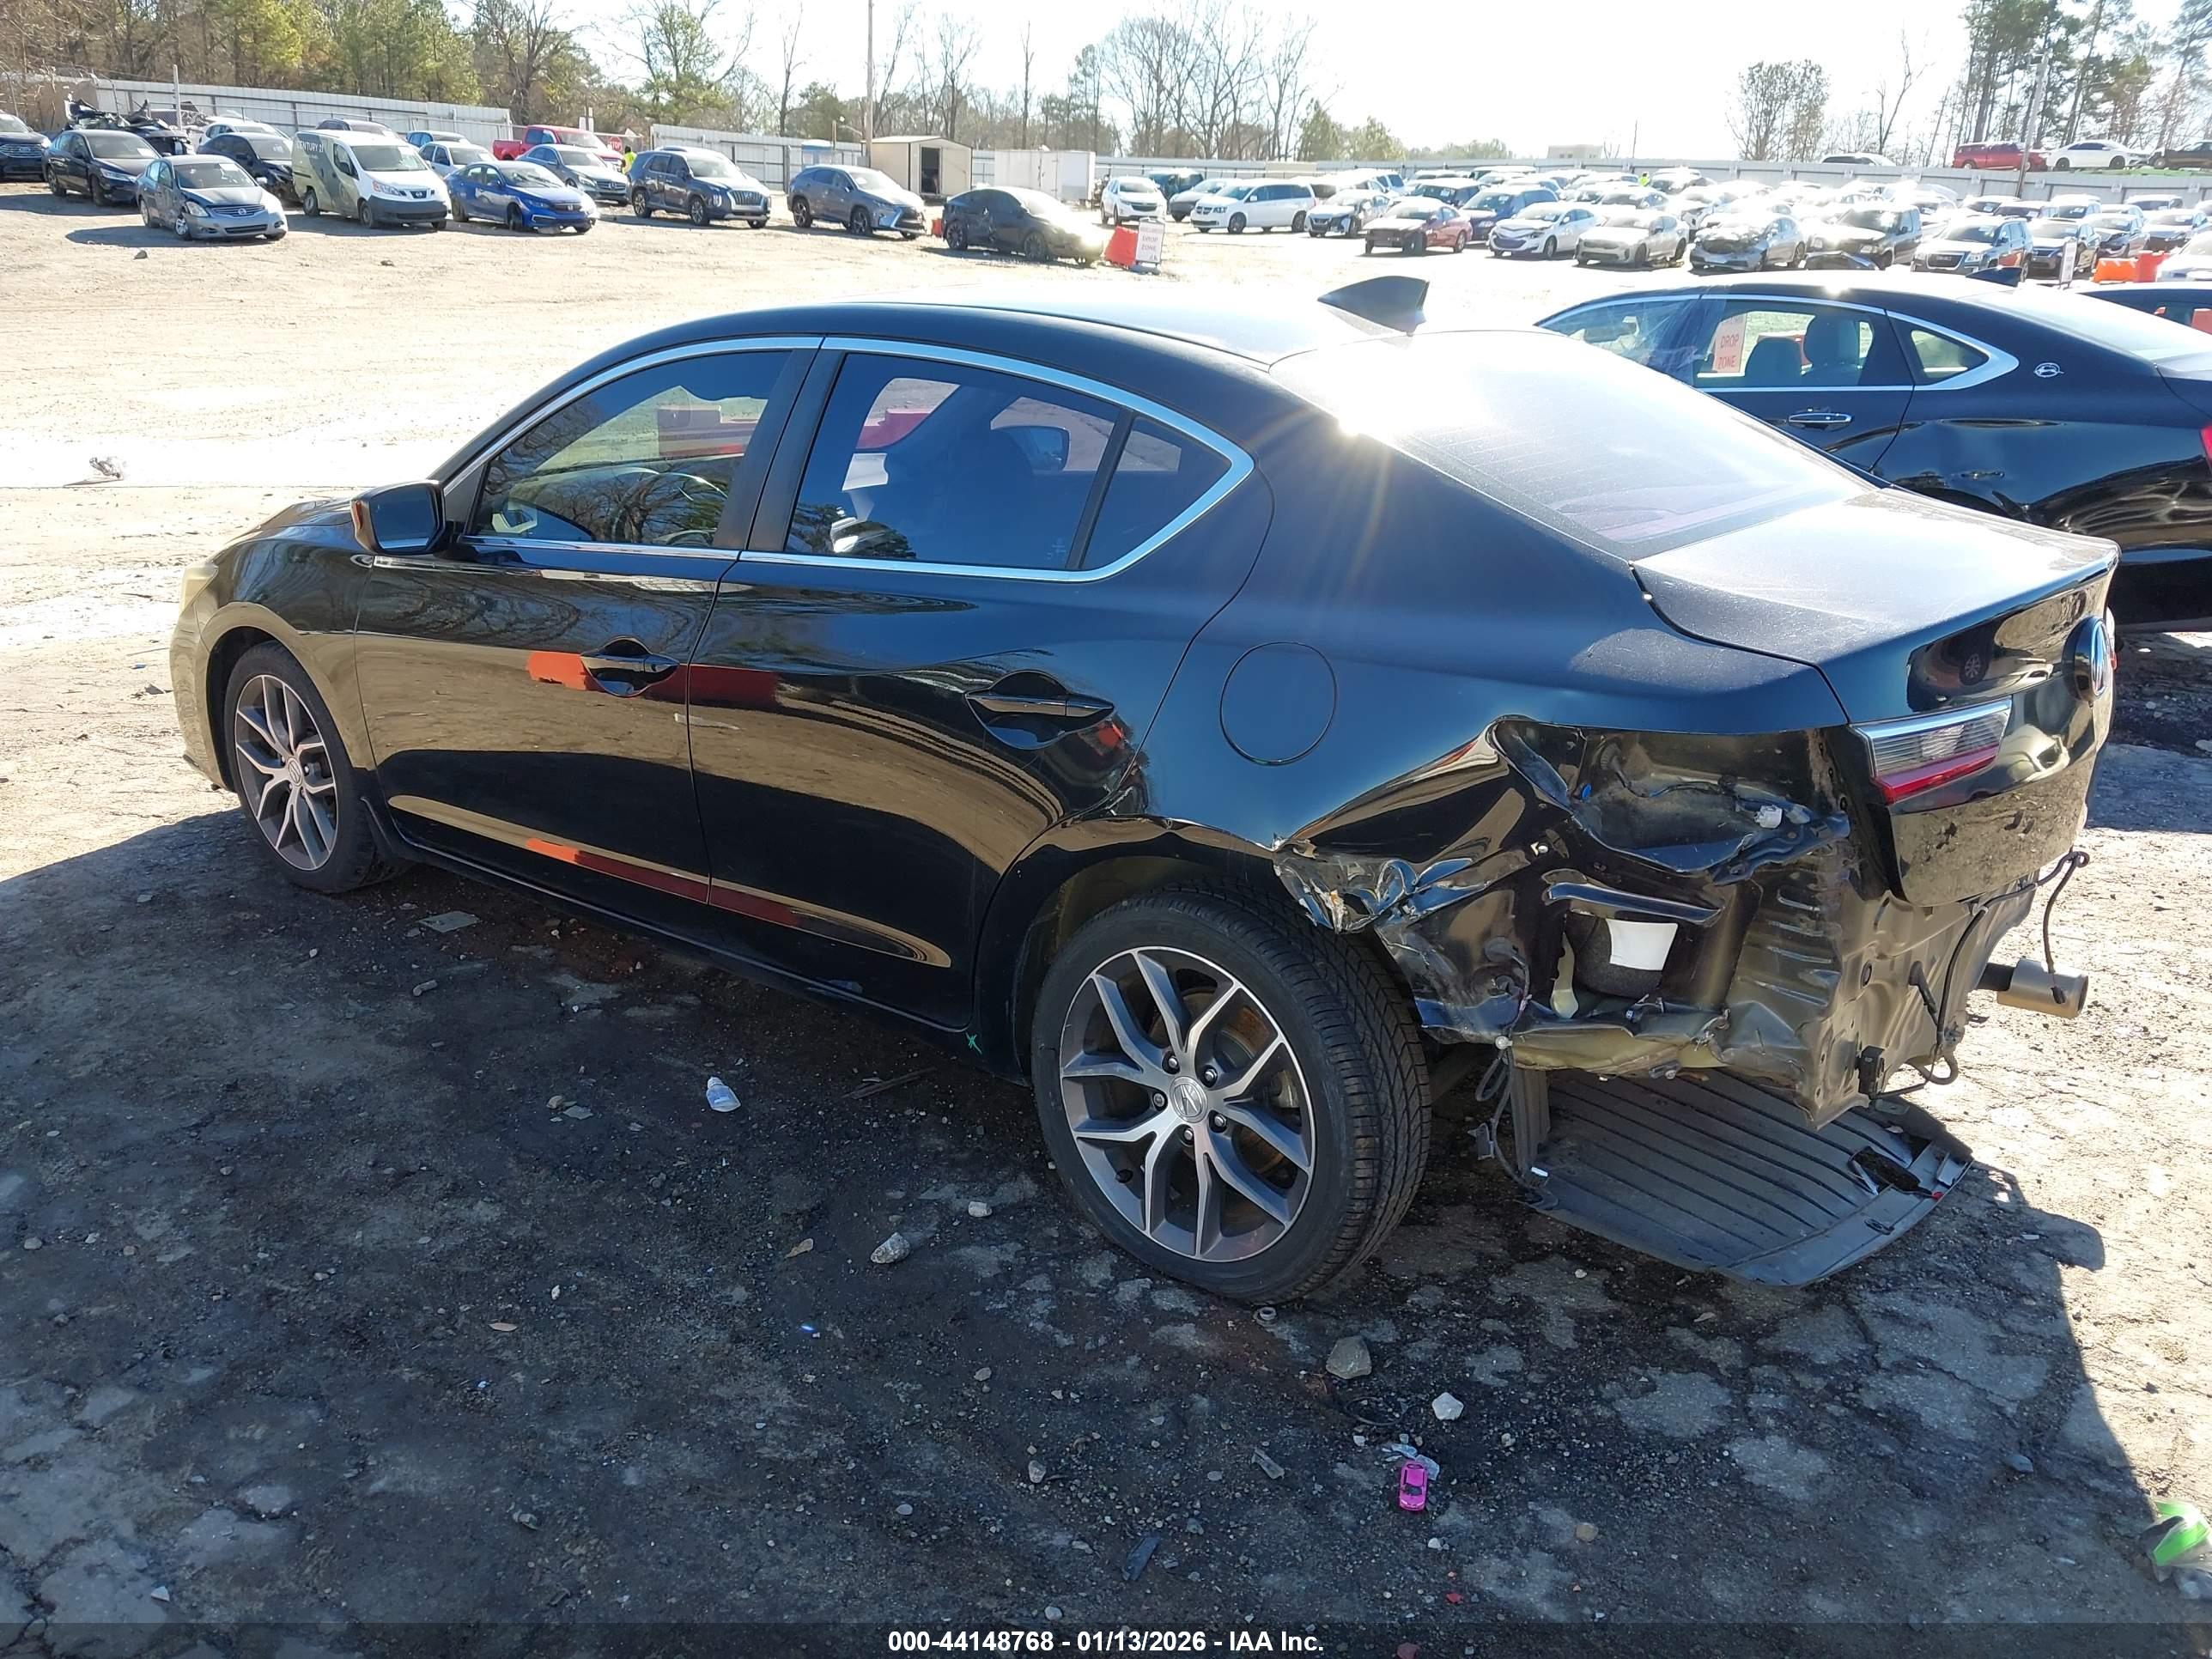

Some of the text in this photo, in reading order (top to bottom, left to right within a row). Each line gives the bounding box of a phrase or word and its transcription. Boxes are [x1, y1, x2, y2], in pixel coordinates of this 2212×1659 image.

[296, 140, 319, 152] CENTURY
[1720, 333, 1739, 348] DROP
[1717, 355, 1736, 369] ZONE
